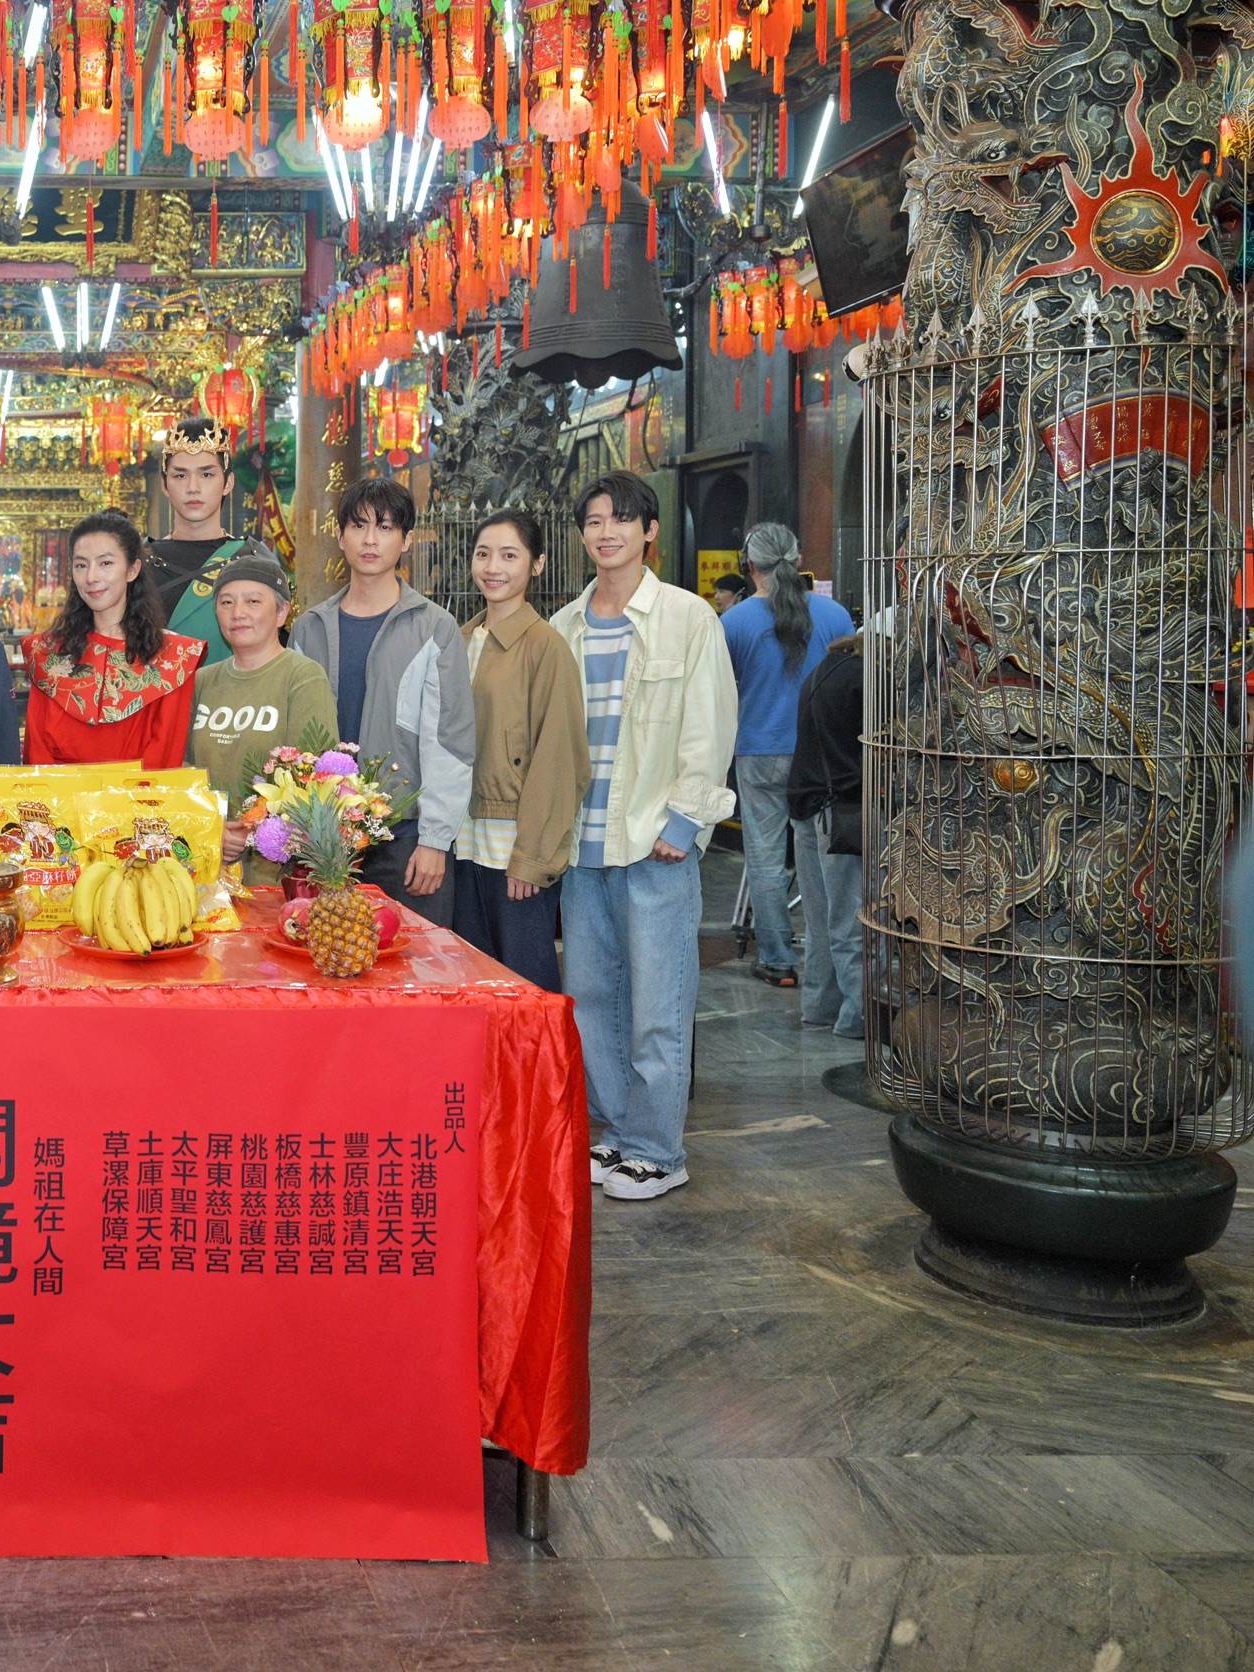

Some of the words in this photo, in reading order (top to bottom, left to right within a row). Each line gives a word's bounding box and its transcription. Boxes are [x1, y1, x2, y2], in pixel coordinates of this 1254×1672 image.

[193, 703, 279, 732] GOOD
[444, 1081, 465, 1153] 出品人
[33, 1137, 65, 1297] 媽祖在人間
[101, 1131, 129, 1270] 草漯保障宮
[136, 1131, 163, 1271] 土庫順天宮
[170, 1131, 199, 1272] 太平聖和宮
[205, 1133, 233, 1274] 屏東慈鳳宮
[239, 1134, 268, 1274] 桃園慈護宮
[274, 1134, 301, 1275] 板橋慈惠宮
[343, 1132, 370, 1275] 豐原鎮清宮
[377, 1132, 403, 1275] 大庄浩天宮
[411, 1134, 438, 1277] 北港朝天宮
